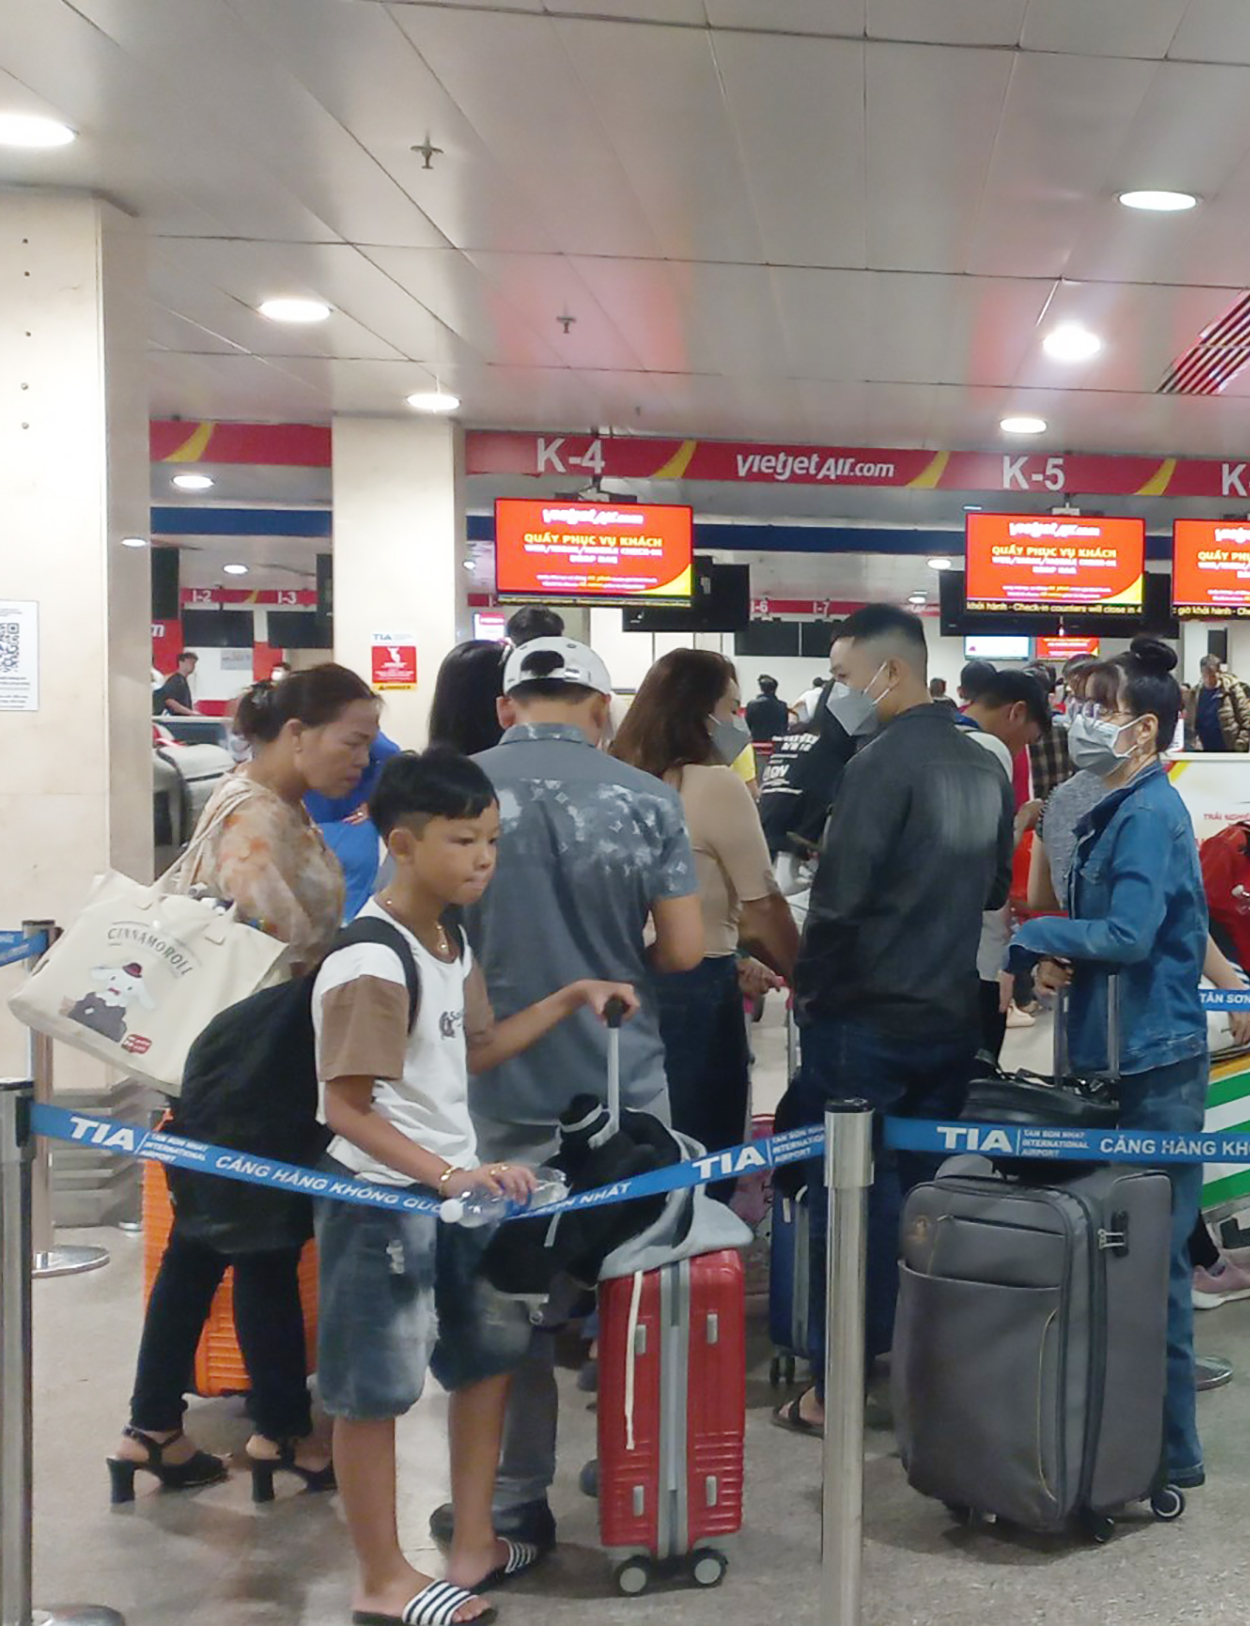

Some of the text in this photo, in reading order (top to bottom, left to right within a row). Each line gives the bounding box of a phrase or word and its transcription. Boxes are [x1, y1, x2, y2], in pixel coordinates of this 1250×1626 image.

[536, 437, 606, 474] K-4
[1002, 454, 1064, 492] K-5
[192, 590, 212, 602] I-2
[278, 592, 297, 604] I-3
[1013, 603, 1049, 611] Check-in
[1088, 604, 1101, 613] will
[1103, 605, 1126, 613] close
[1200, 993, 1225, 1003] TÂN
[70, 1116, 134, 1151] TIA
[936, 1126, 1014, 1152] TIA
[1022, 1139, 1090, 1149] INTERNATIONAL
[1100, 1135, 1156, 1155] CẢNG
[1161, 1137, 1214, 1156] HÀNG
[692, 1146, 767, 1179] TIA
[215, 1151, 270, 1178] CẢNG
[274, 1166, 328, 1190] HÀNG
[329, 1181, 399, 1205] KHÔNG
[580, 1181, 633, 1204] NHẤT
